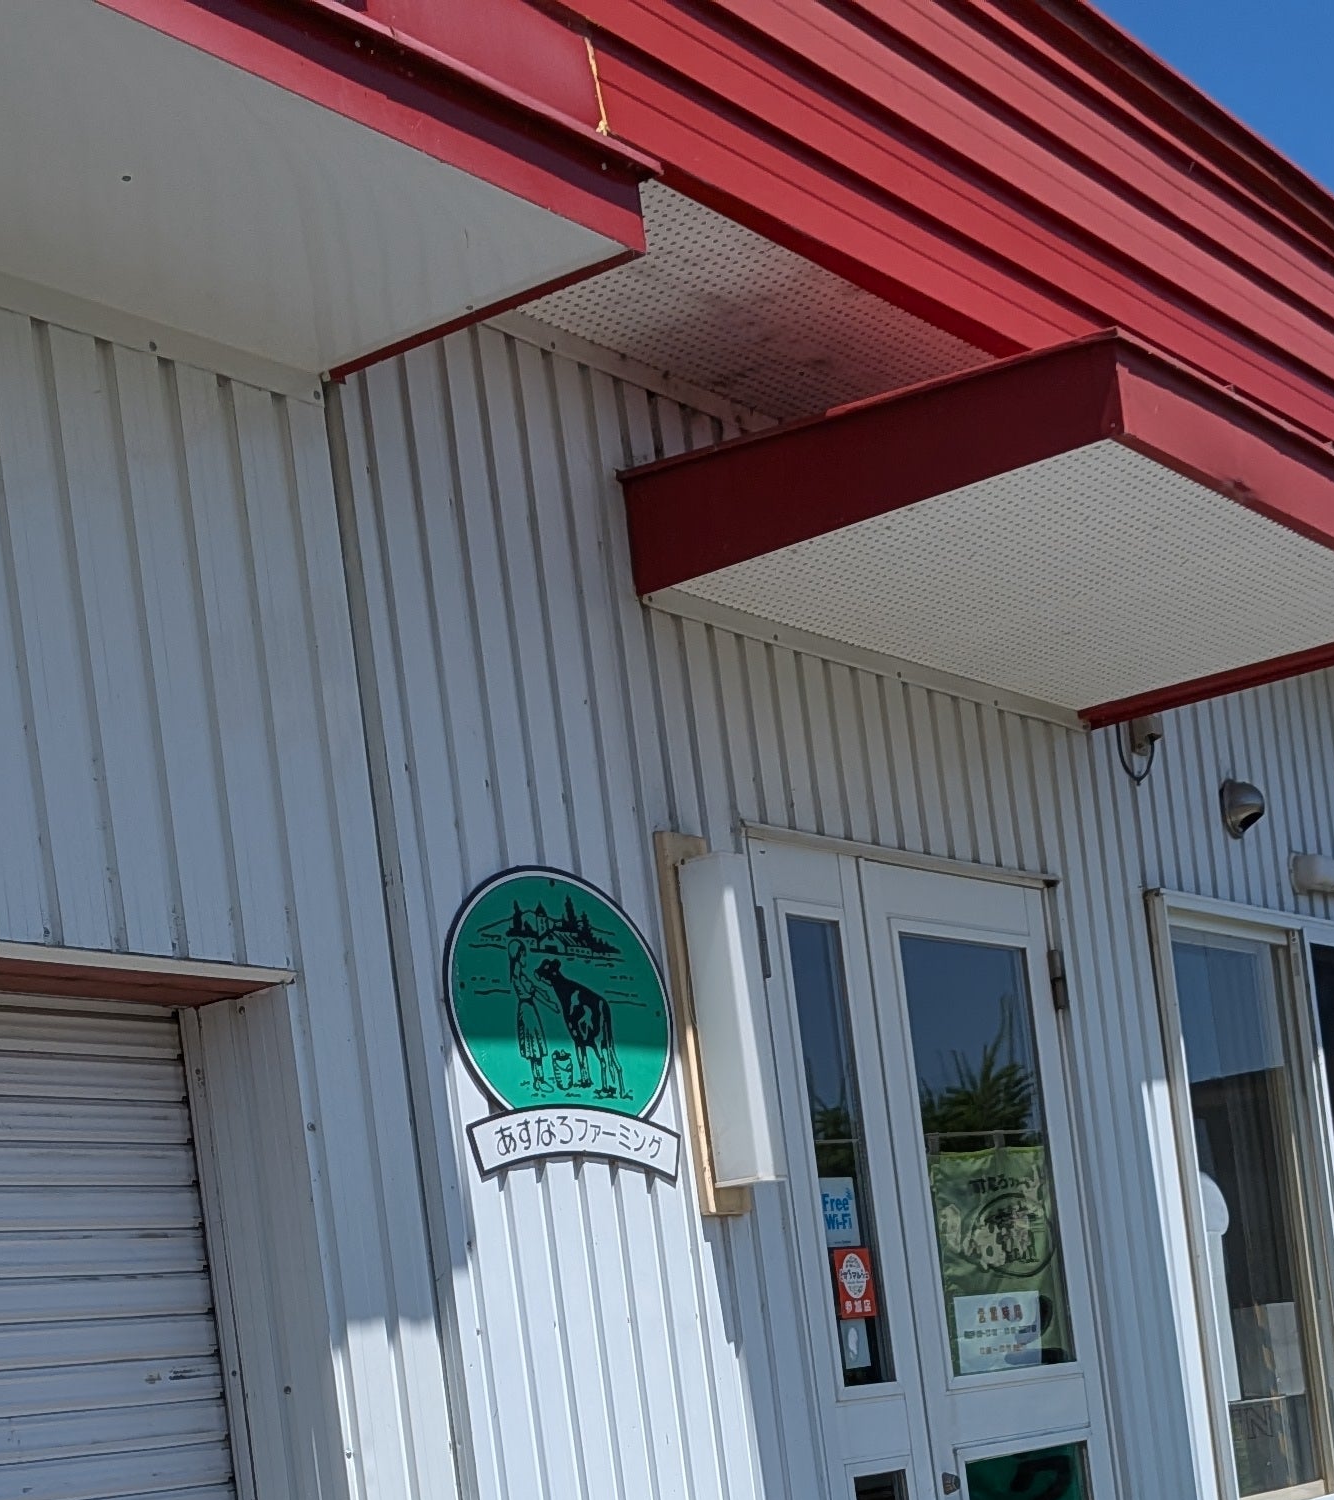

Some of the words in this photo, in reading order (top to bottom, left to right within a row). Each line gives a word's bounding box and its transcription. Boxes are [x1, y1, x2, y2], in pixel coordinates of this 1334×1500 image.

[495, 1115, 663, 1159] あすなろファーミング
[821, 1192, 850, 1212] Free
[824, 1213, 853, 1230] Wi-Fi
